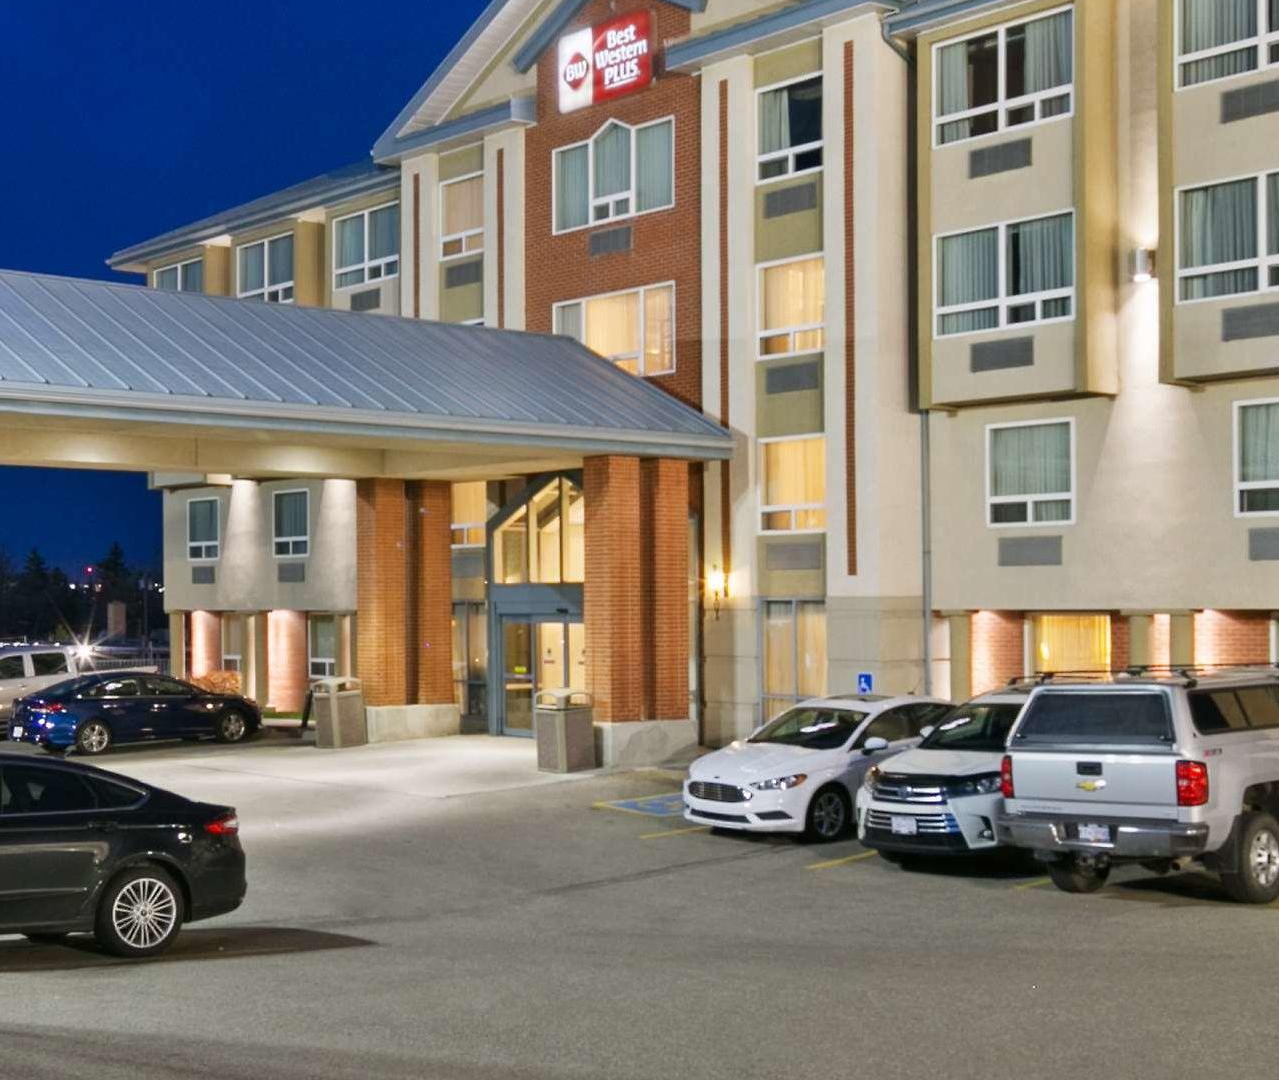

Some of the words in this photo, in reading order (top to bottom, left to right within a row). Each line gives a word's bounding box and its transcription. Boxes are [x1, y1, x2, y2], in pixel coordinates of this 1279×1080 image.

[607, 24, 636, 49] Best
[595, 39, 648, 69] Western
[565, 60, 587, 82] BW
